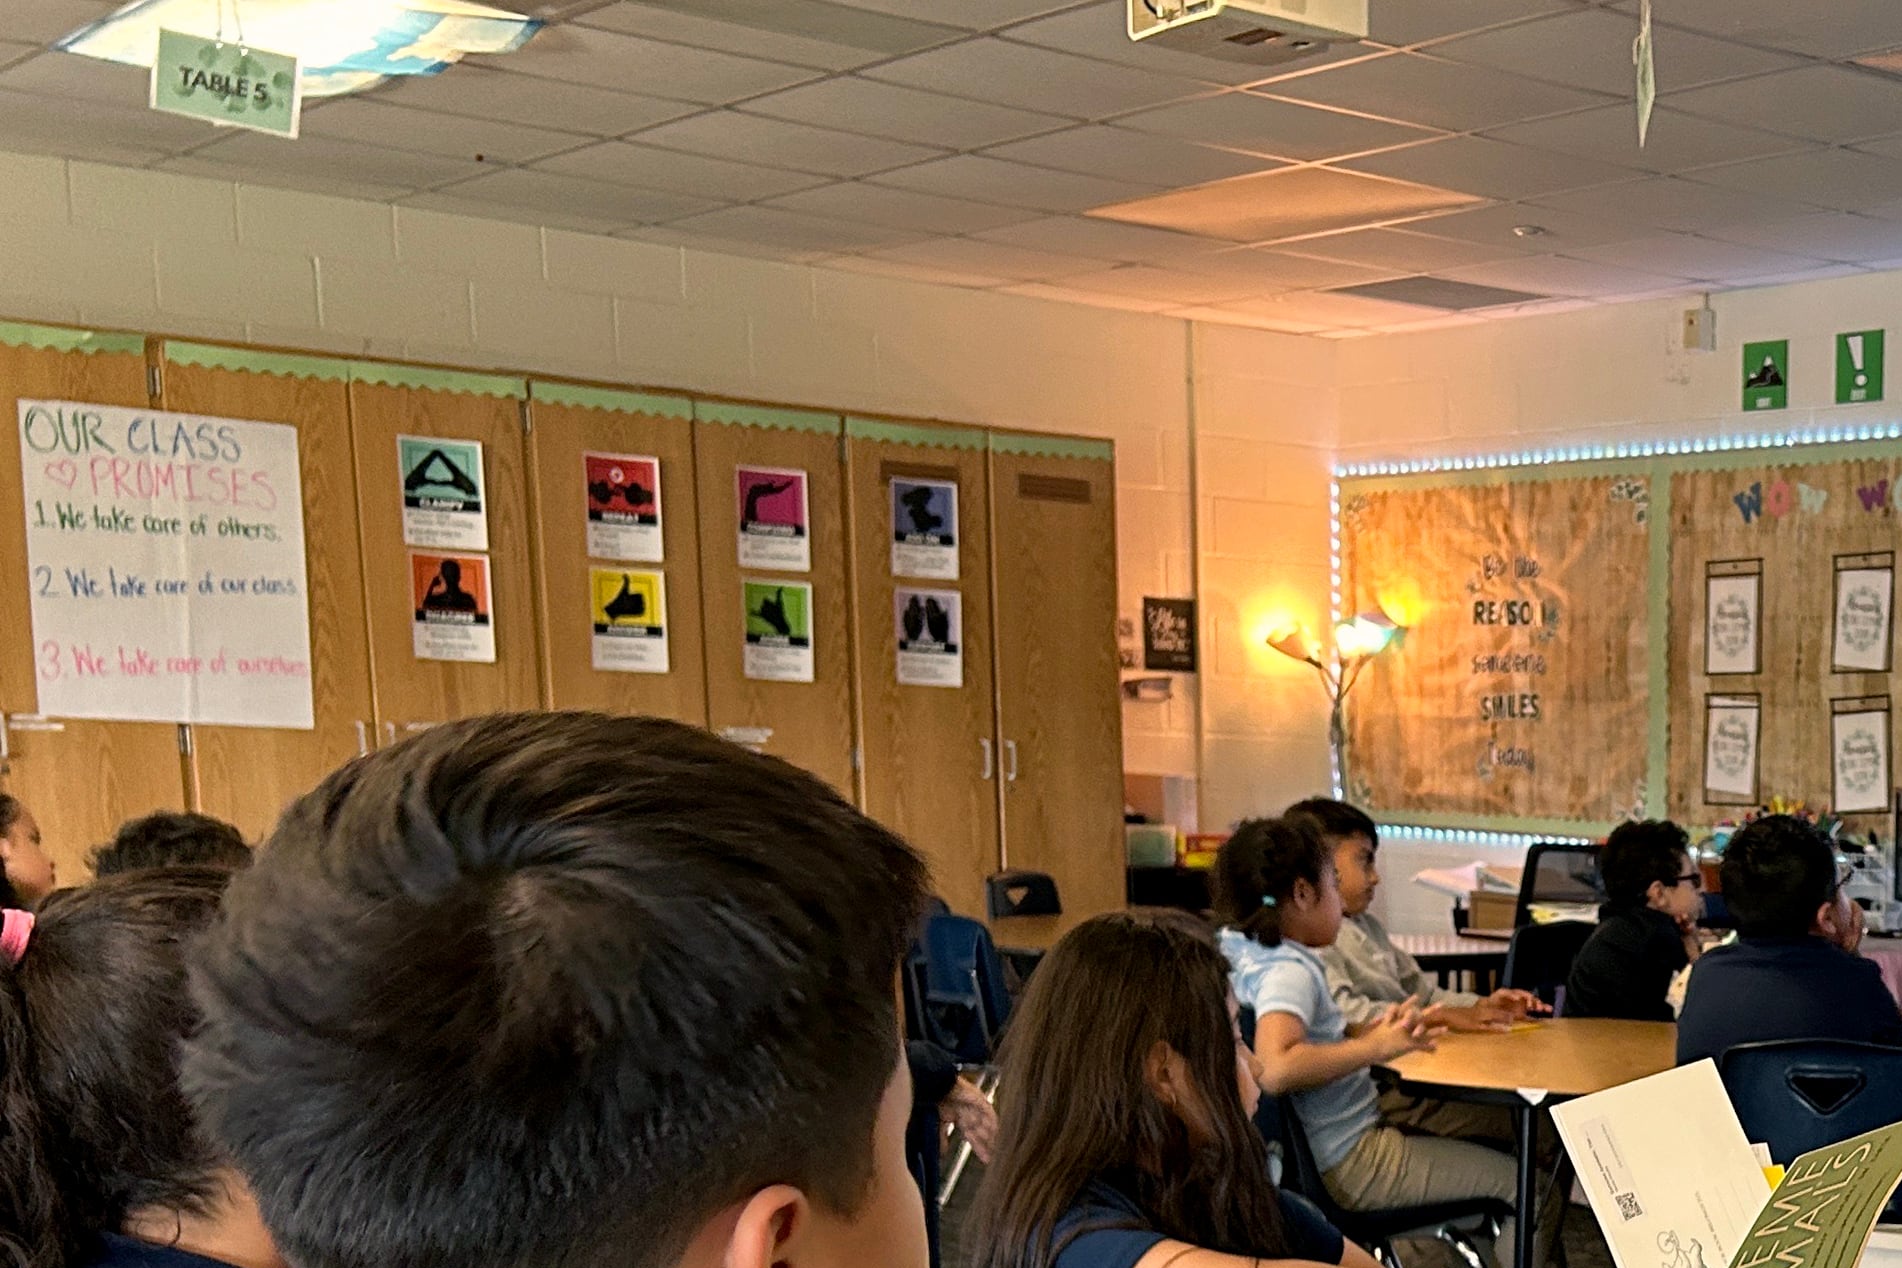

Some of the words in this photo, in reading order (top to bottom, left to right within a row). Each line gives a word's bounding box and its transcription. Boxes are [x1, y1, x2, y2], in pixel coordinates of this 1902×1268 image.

[179, 65, 249, 98] TABLE
[253, 83, 268, 103] 5
[25, 405, 116, 455] OUR
[127, 416, 242, 464] CLASS
[90, 455, 278, 512] PROMISES
[56, 502, 87, 531] We
[93, 504, 137, 532] take
[143, 515, 182, 535] care
[190, 513, 208, 536] of
[65, 566, 103, 599] We
[109, 566, 147, 599] take
[155, 578, 188, 597] care
[198, 570, 214, 596] of
[72, 643, 106, 677] We
[117, 643, 158, 677] take
[211, 646, 227, 675] of
[1481, 693, 1542, 720] SMILES
